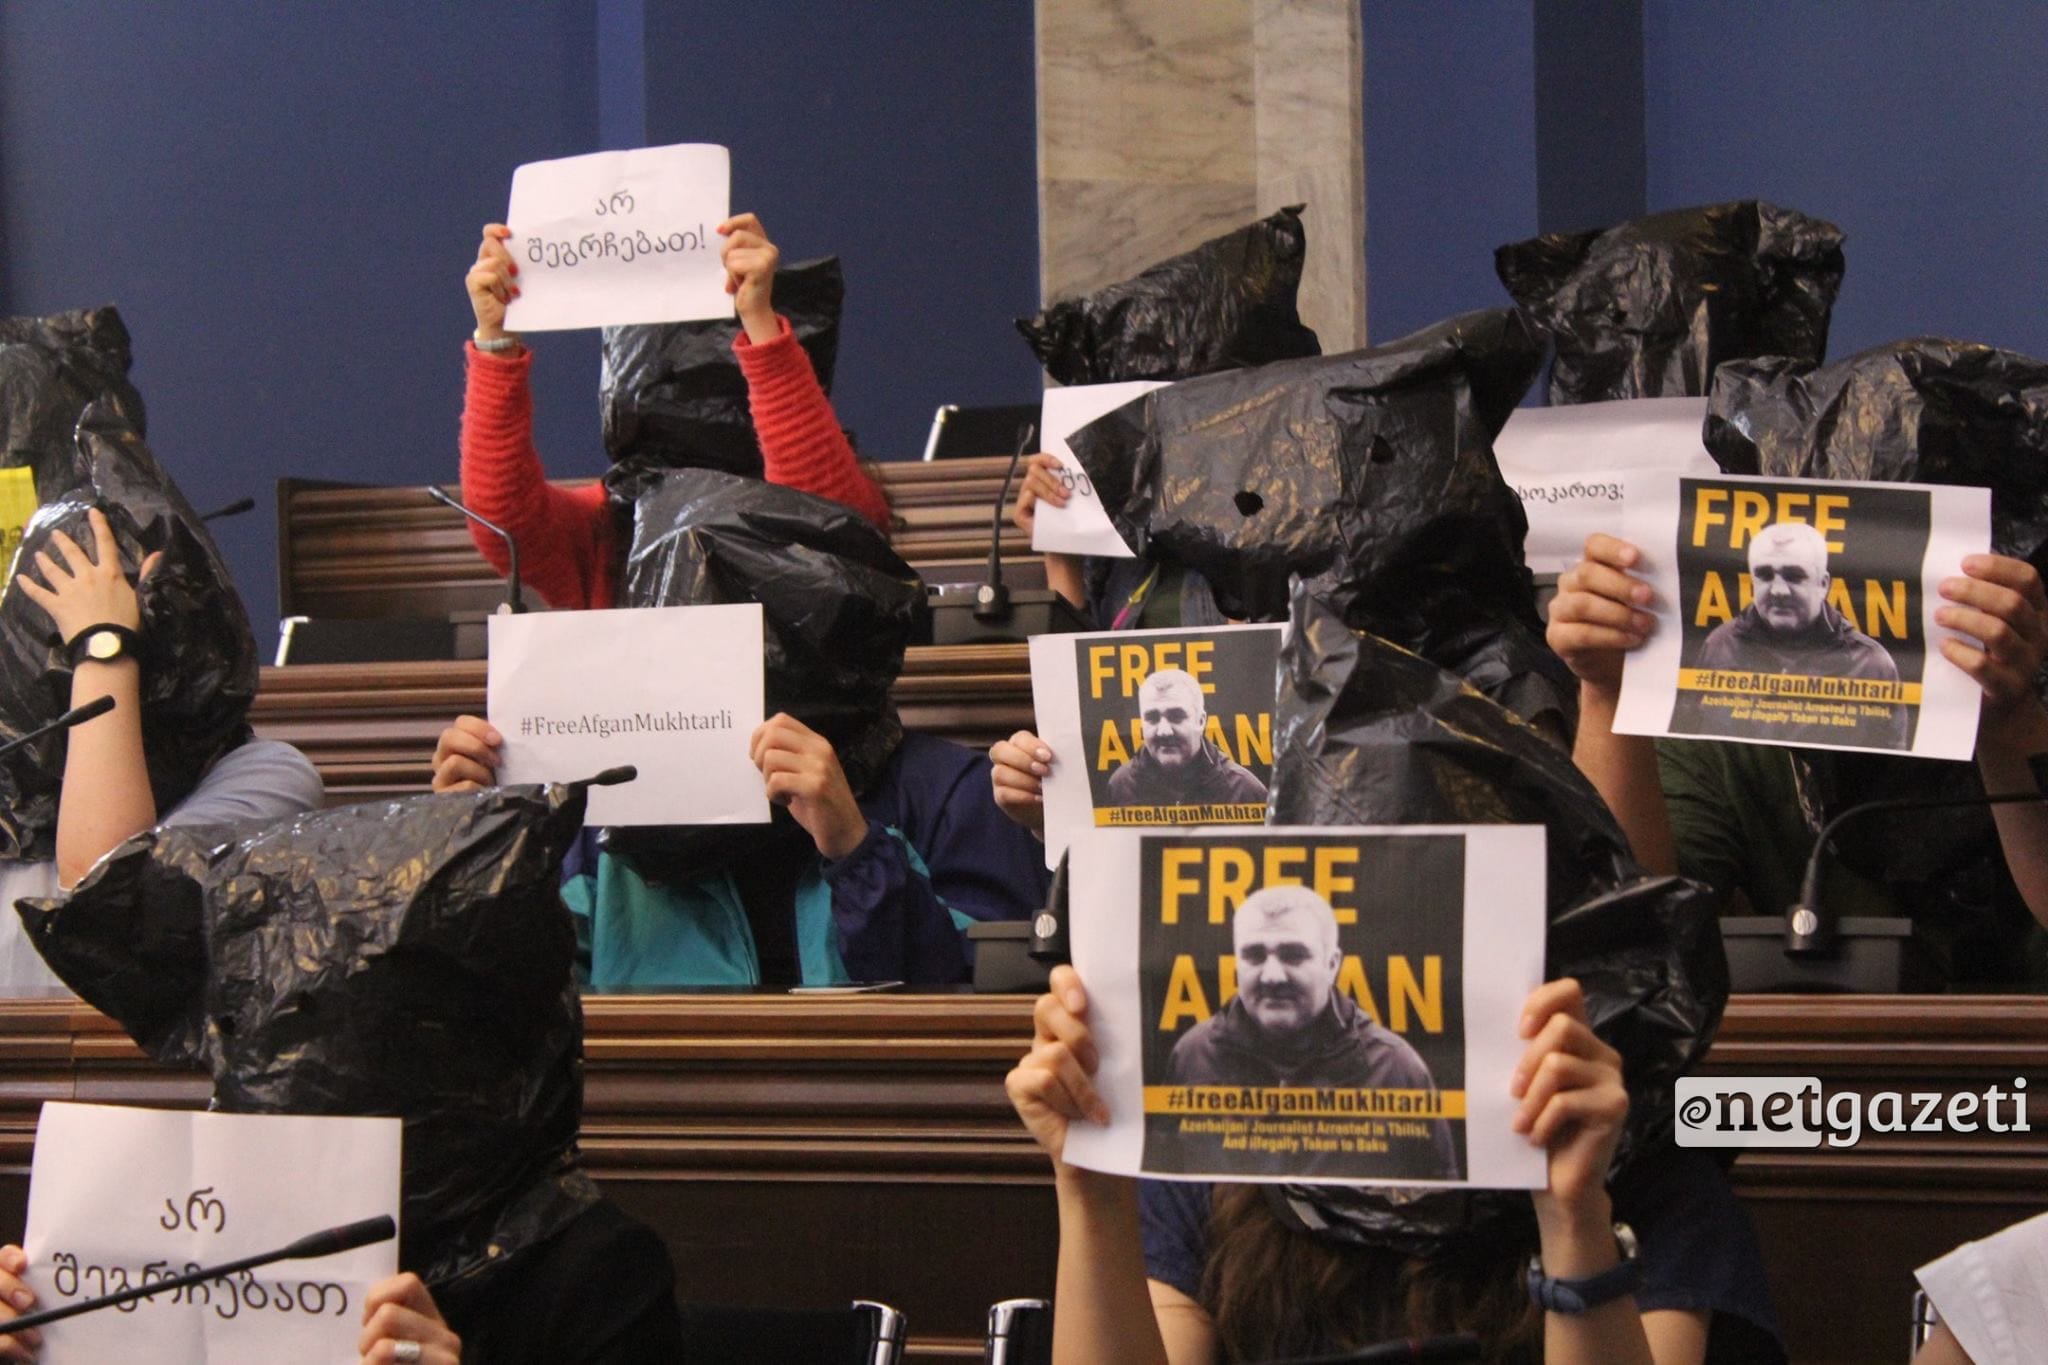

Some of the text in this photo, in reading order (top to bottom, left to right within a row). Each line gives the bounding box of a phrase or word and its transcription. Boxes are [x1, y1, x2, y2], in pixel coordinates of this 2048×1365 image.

[594, 188, 636, 217] არ
[527, 223, 707, 268] შეგრჩებათ!
[1694, 570, 1909, 640] AAN
[520, 710, 733, 739] #FreeAfganMukhtarli
[1097, 712, 1275, 772] AAN
[1160, 847, 1360, 924] FREE
[1159, 954, 1444, 1034] AAN
[159, 1186, 226, 1234] არ
